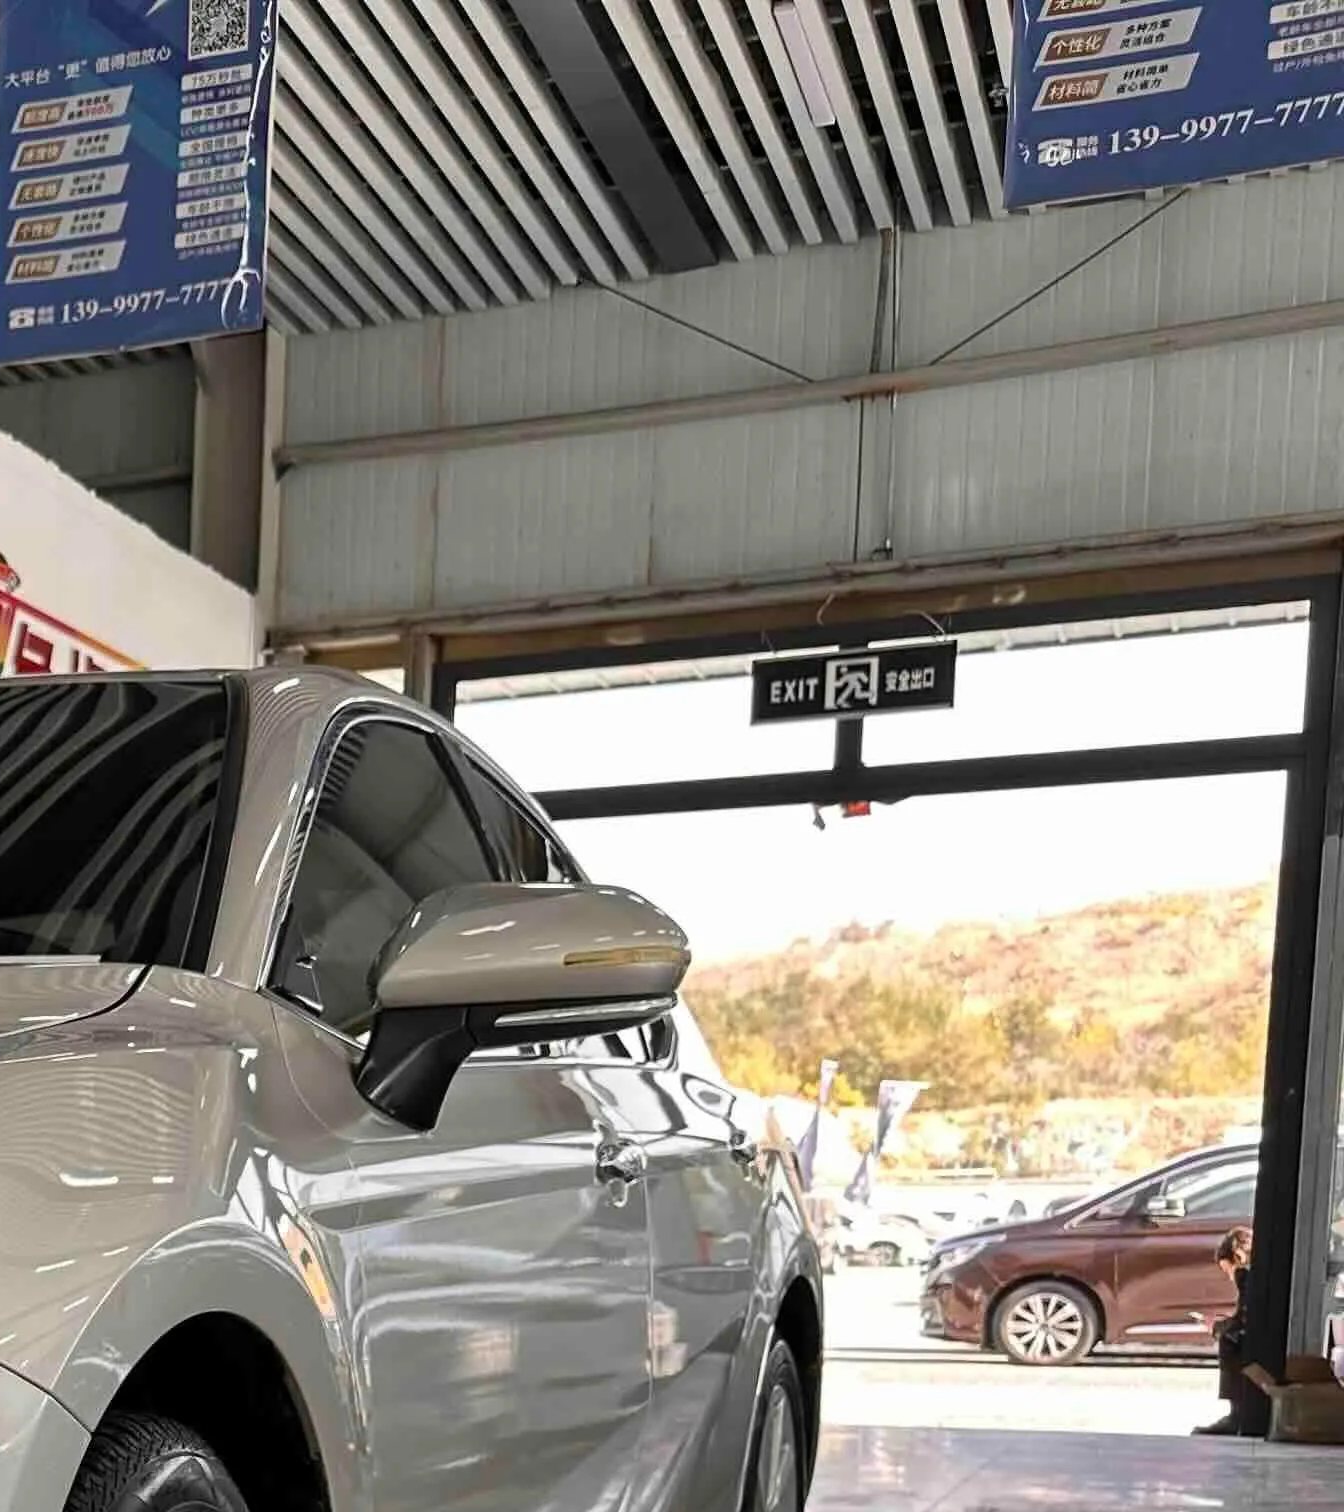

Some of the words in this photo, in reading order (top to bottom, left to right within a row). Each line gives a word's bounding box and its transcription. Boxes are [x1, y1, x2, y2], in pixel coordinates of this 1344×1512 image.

[1053, 34, 1101, 55] 个性化
[4, 68, 51, 89] 大平台
[1049, 79, 1099, 101] 材料简
[770, 677, 819, 704] EXIT
[884, 666, 936, 693] 安全出口
